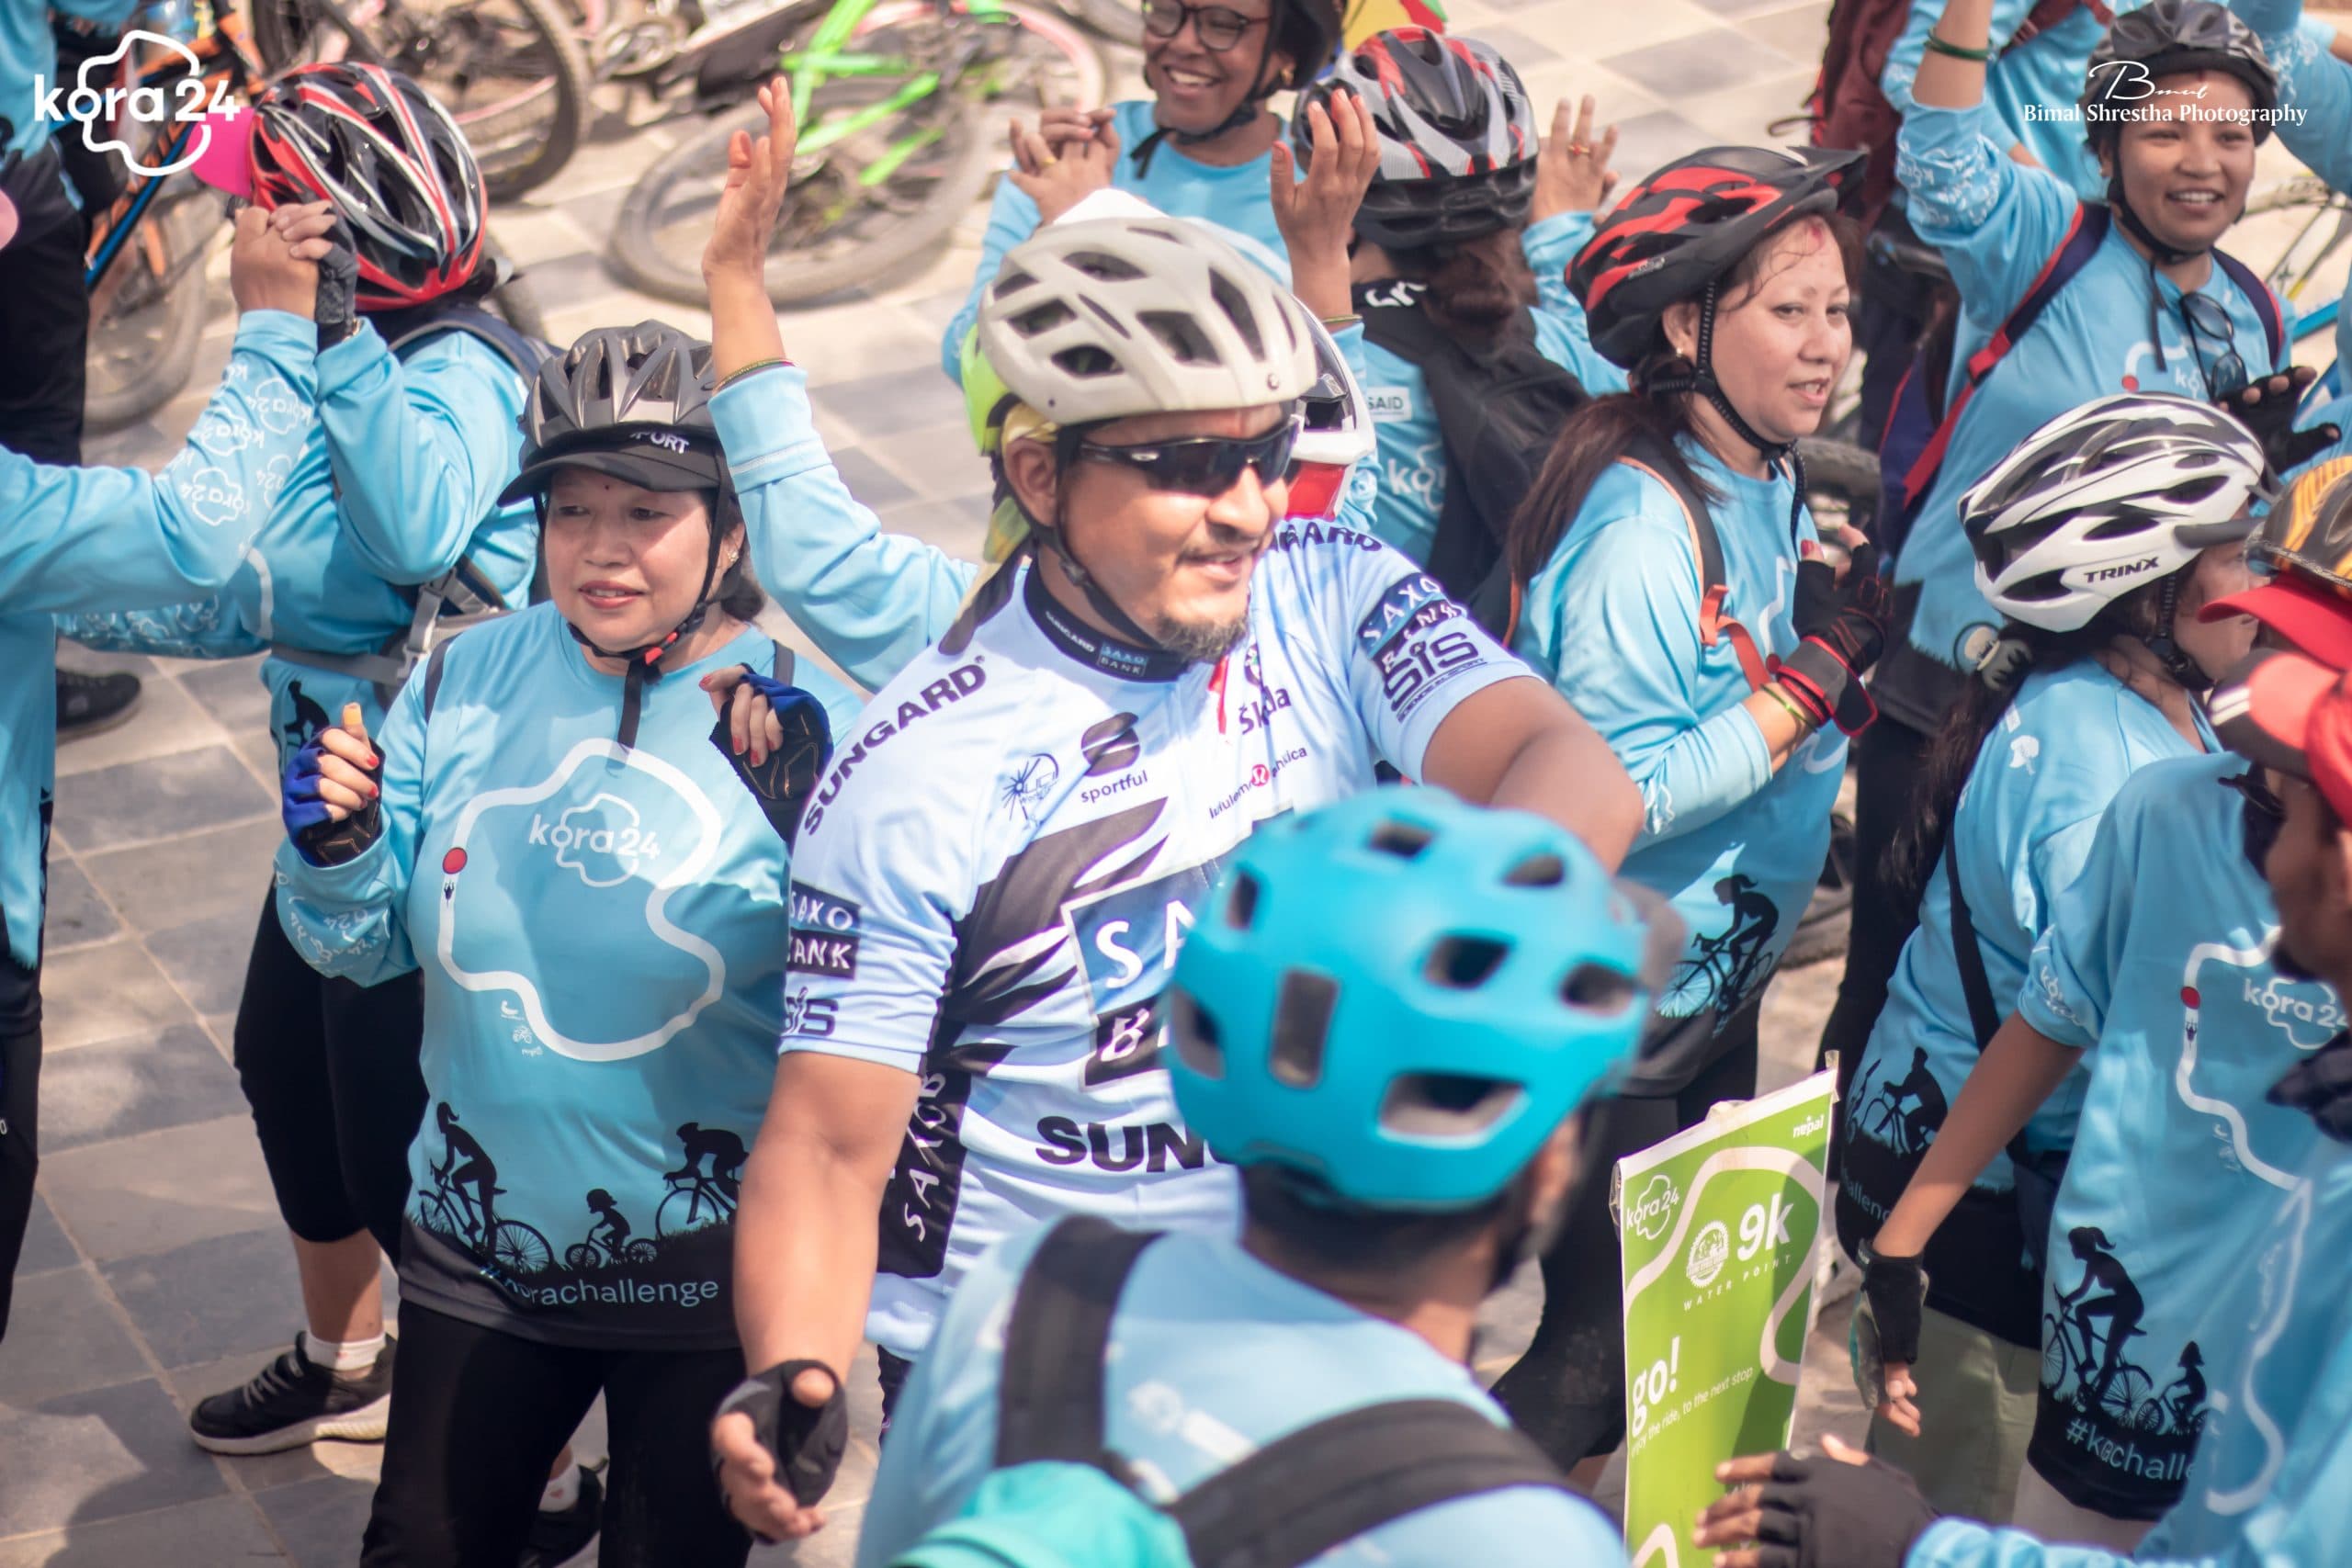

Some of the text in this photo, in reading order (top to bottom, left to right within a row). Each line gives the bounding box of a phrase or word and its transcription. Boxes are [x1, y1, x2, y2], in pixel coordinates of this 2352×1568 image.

[2083, 556, 2159, 583] TRINX
[1080, 769, 1148, 804] sportful
[1737, 1192, 1794, 1261] 9k
[1683, 1279, 1732, 1311] WATER
[1742, 1255, 1792, 1282] POINT
[1631, 1335, 1681, 1438] go!
[1682, 1401, 1692, 1415] to
[1693, 1390, 1709, 1408] the
[1710, 1376, 1730, 1398] next
[1731, 1366, 1754, 1386] stop
